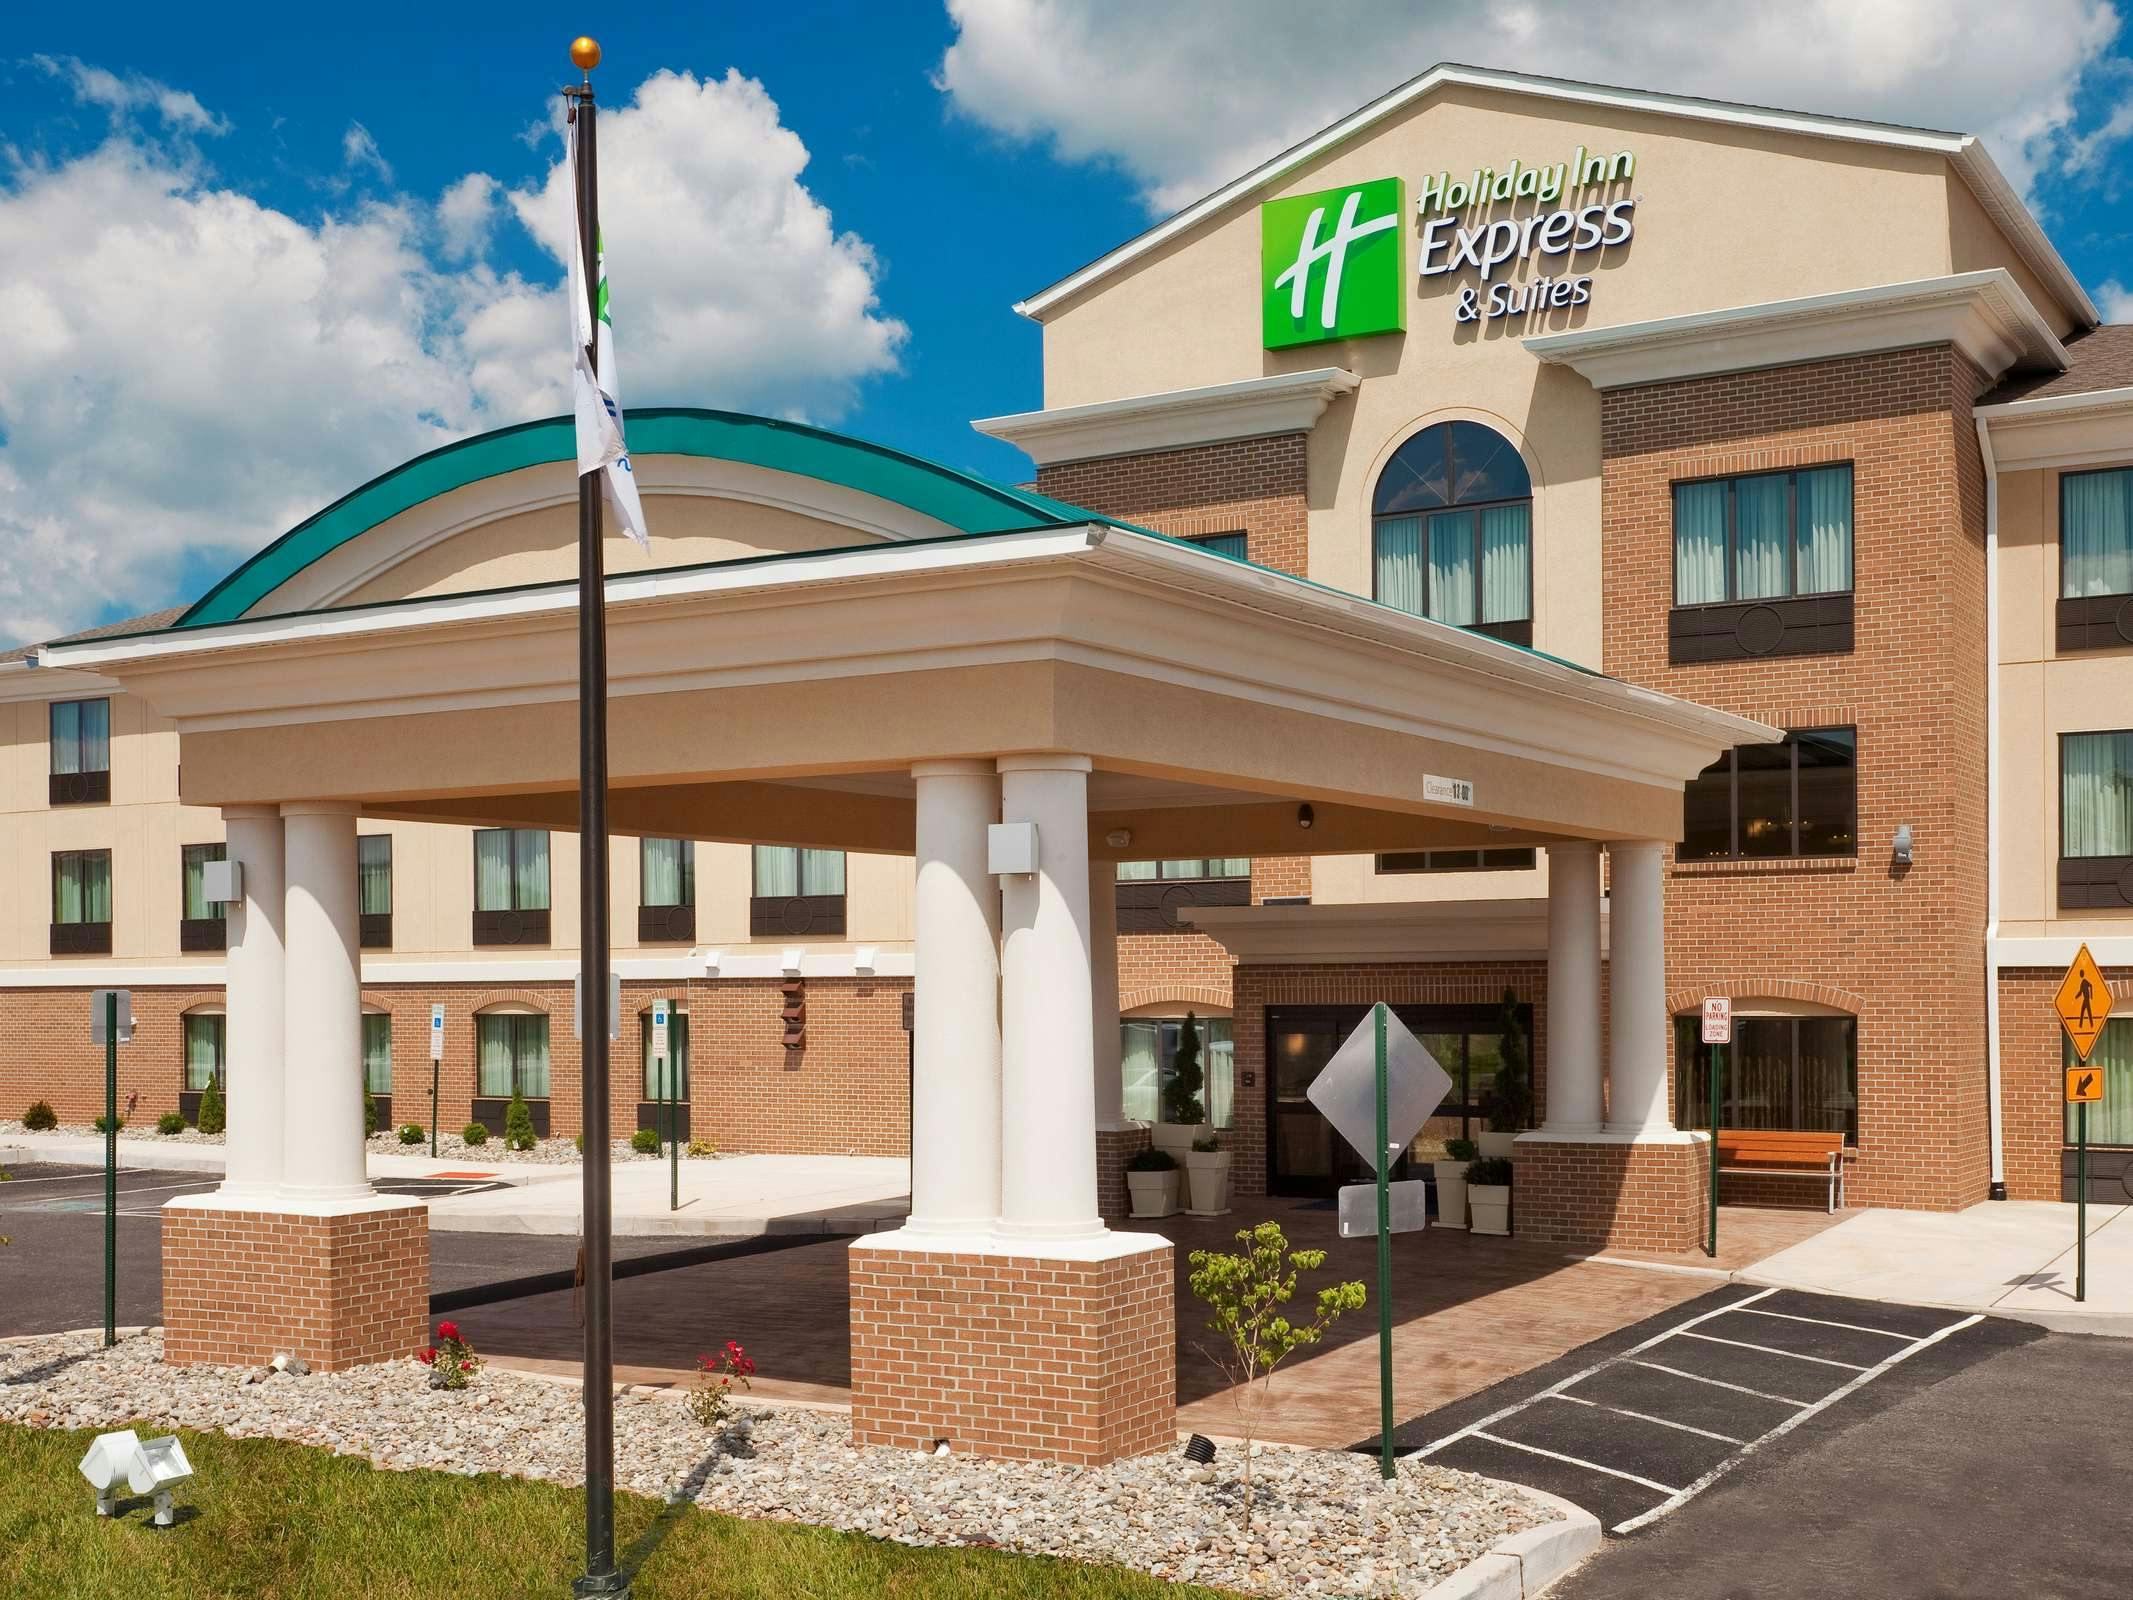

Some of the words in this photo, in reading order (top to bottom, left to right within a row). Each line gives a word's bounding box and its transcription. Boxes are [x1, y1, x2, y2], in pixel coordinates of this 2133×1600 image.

[1416, 158, 1567, 215] Holiday
[1571, 145, 1637, 188] Inn
[1417, 200, 1635, 281] Express
[1454, 287, 1482, 324] &
[1485, 276, 1594, 320] Suites
[1705, 1012, 1727, 1020] PARKING
[1711, 1003, 1722, 1011] NO
